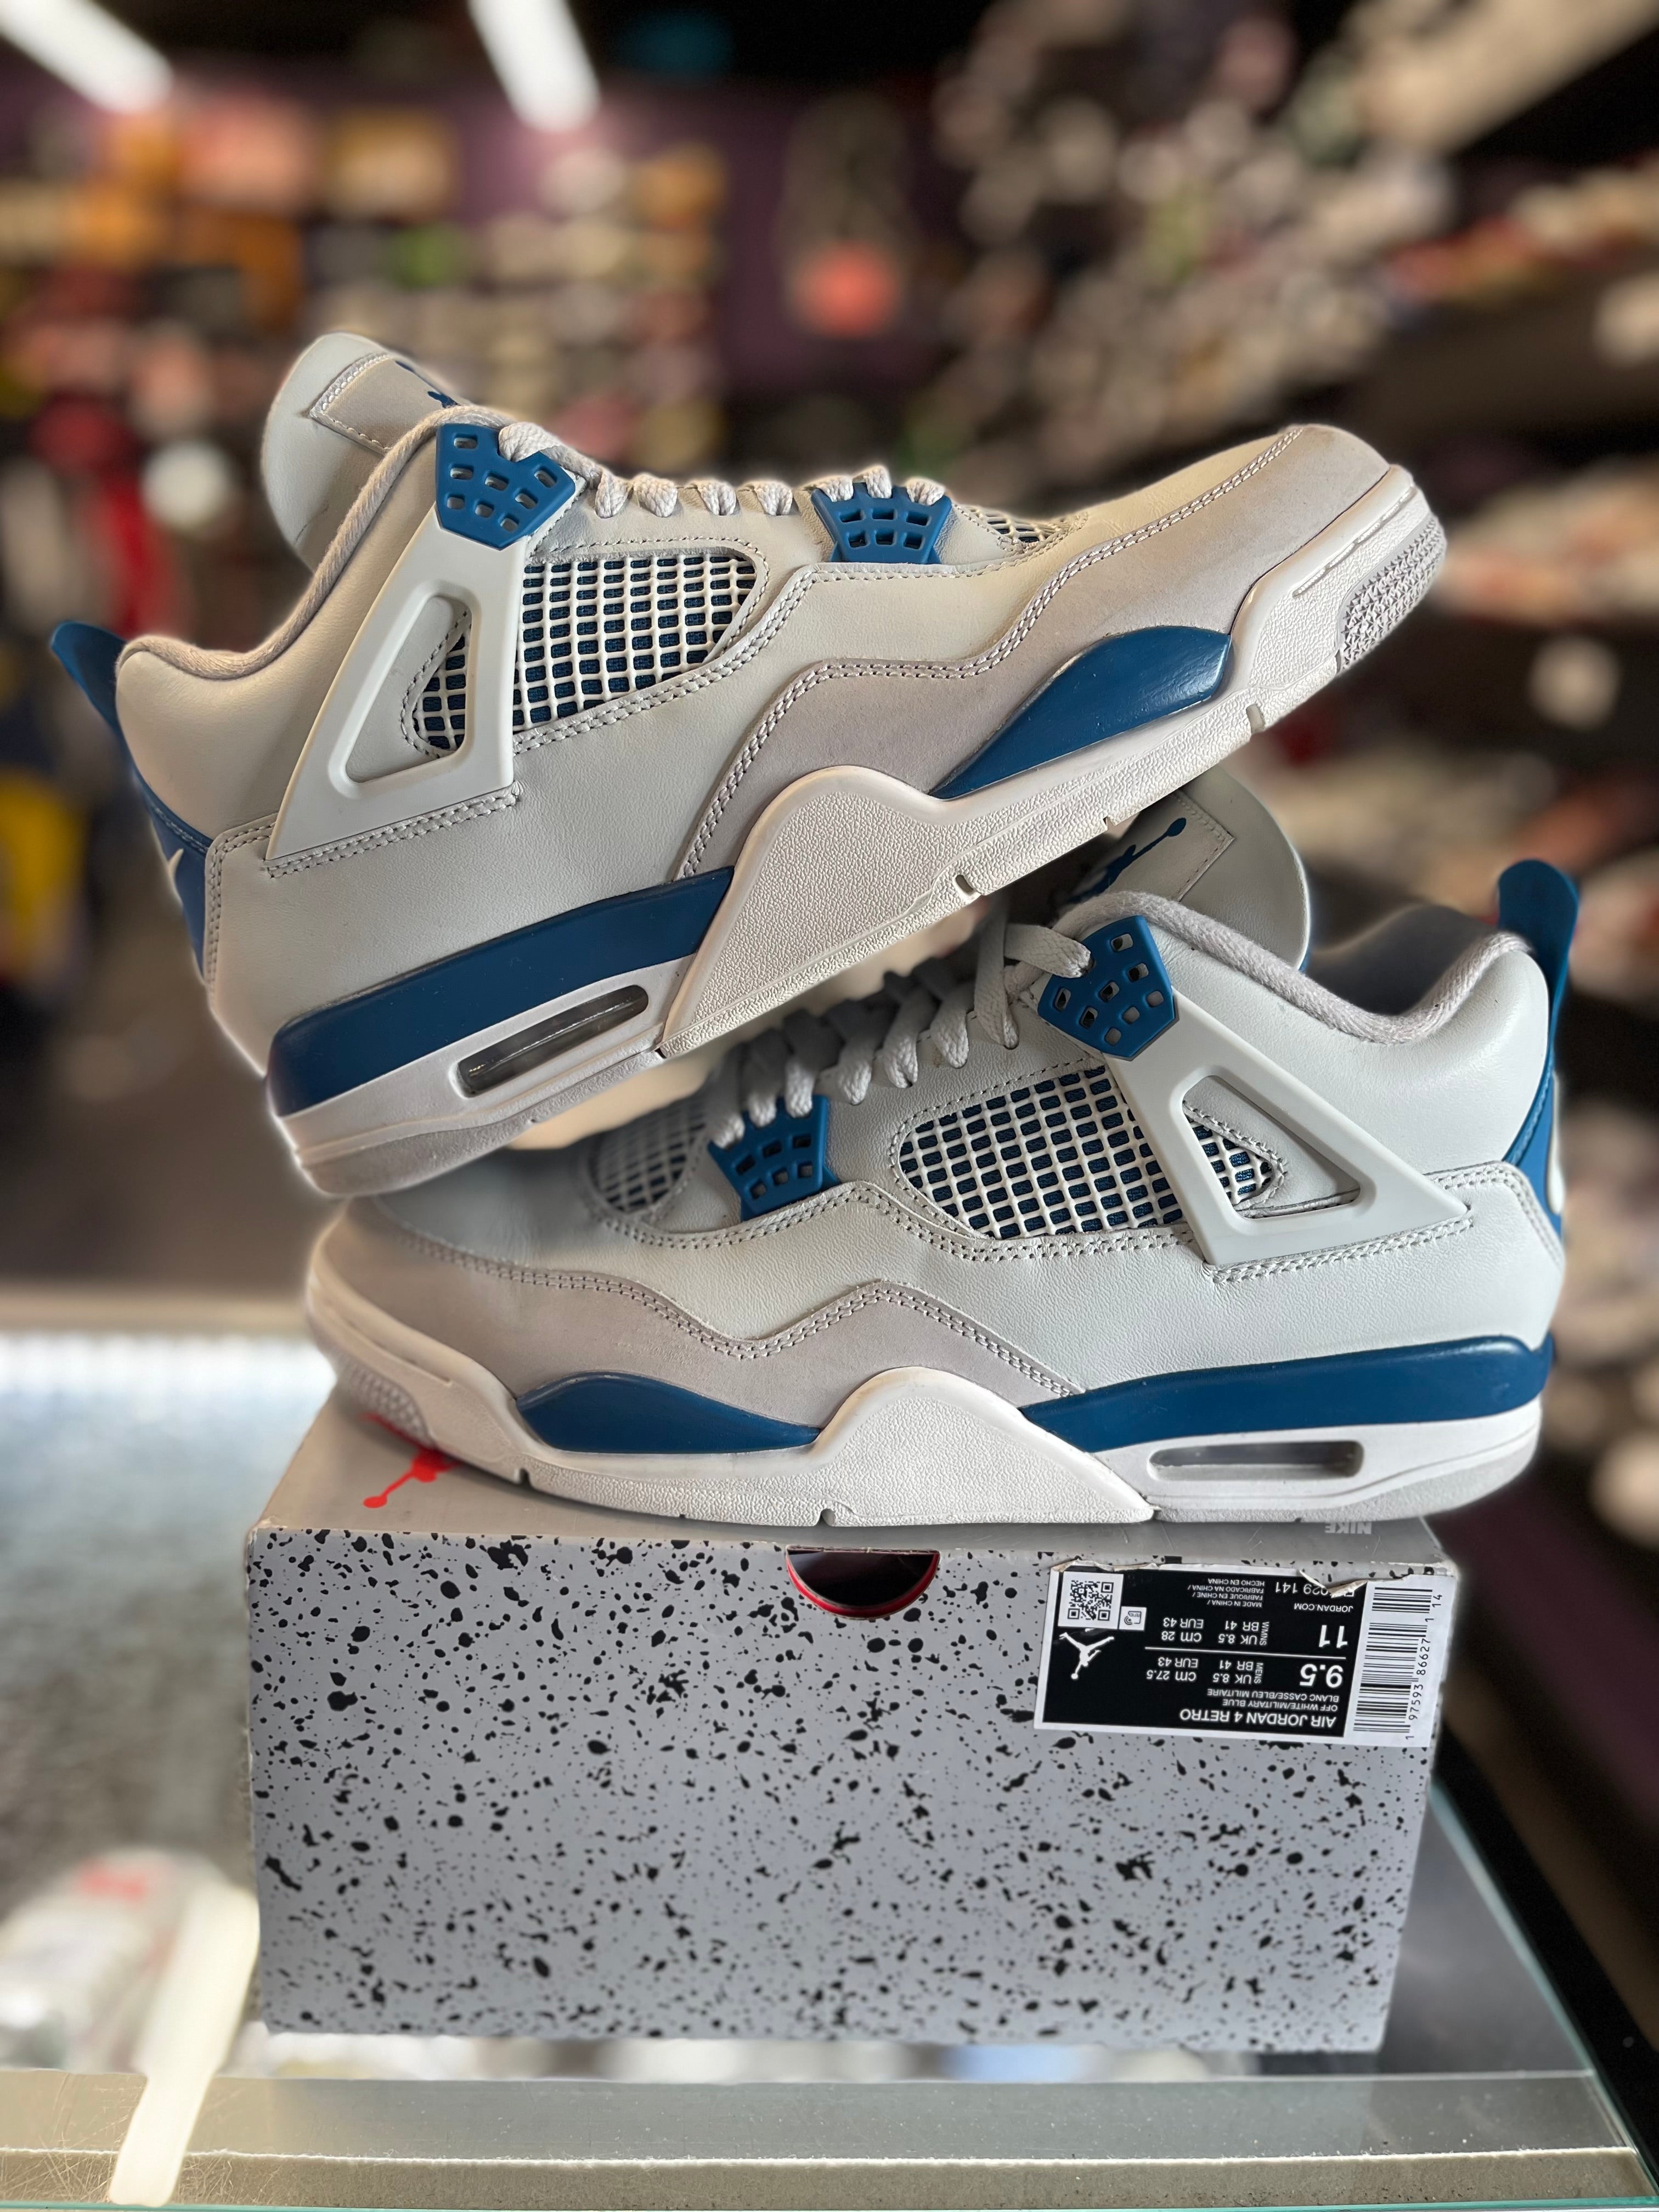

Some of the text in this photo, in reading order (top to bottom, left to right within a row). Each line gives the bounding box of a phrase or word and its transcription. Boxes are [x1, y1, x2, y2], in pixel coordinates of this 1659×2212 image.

[1325, 1522, 1372, 1534] NIKE
[1275, 1582, 1298, 1594] 141
[1294, 1603, 1353, 1613] JORDAN.COM
[1163, 1617, 1204, 1628] EUR 43
[1224, 1621, 1259, 1631] BR 41
[1161, 1630, 1201, 1643] cm 28
[1218, 1634, 1257, 1645] UK 8.5
[1260, 1621, 1269, 1646] WMNS
[1319, 1625, 1347, 1648] 11
[1158, 1657, 1198, 1668] EUR 43
[1219, 1660, 1254, 1671] BR 41
[1147, 1670, 1196, 1682] cm 27.5
[1212, 1673, 1252, 1684] UK 8.5
[1254, 1662, 1263, 1684] MENS
[1299, 1663, 1343, 1688] 9.5
[1408, 1684, 1423, 1720] 97593
[1417, 1638, 1431, 1675] 86627
[1207, 1689, 1339, 1702] BLANC CASSE/BLEU MILITAIRE
[1222, 1699, 1246, 1707] BLUE
[1248, 1700, 1319, 1711] WHITE/MILITARY
[1180, 1708, 1336, 1728] AIR JORDAN 4 RETRO
